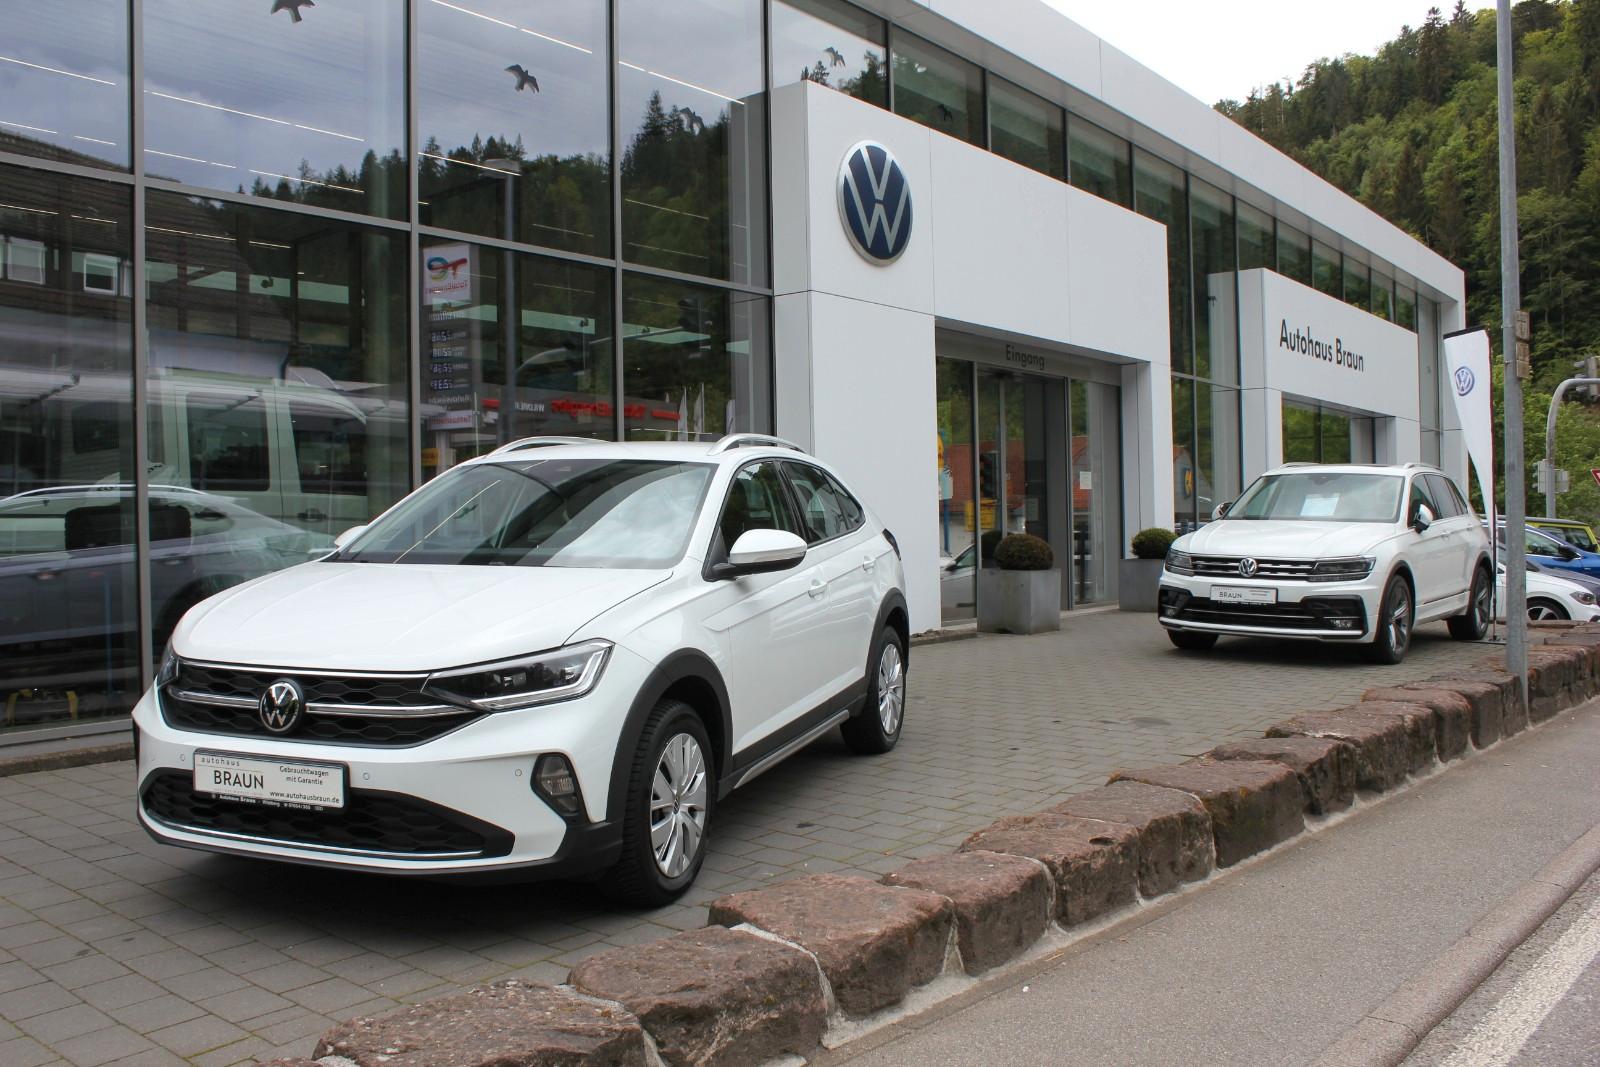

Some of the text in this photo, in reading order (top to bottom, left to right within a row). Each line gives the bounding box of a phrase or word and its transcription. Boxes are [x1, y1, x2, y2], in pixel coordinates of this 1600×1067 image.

[839, 143, 911, 258] VW
[1279, 319, 1364, 372] Autohaus Braun
[1006, 343, 1045, 371] Eingang
[1219, 591, 1242, 599] BRAUN
[201, 757, 240, 767] autohaus
[280, 765, 329, 777] Gebrauchtwagen
[214, 770, 264, 789] BRAUN
[286, 775, 323, 785] mit Garantie
[270, 791, 340, 803] www.autohausbraun.de
